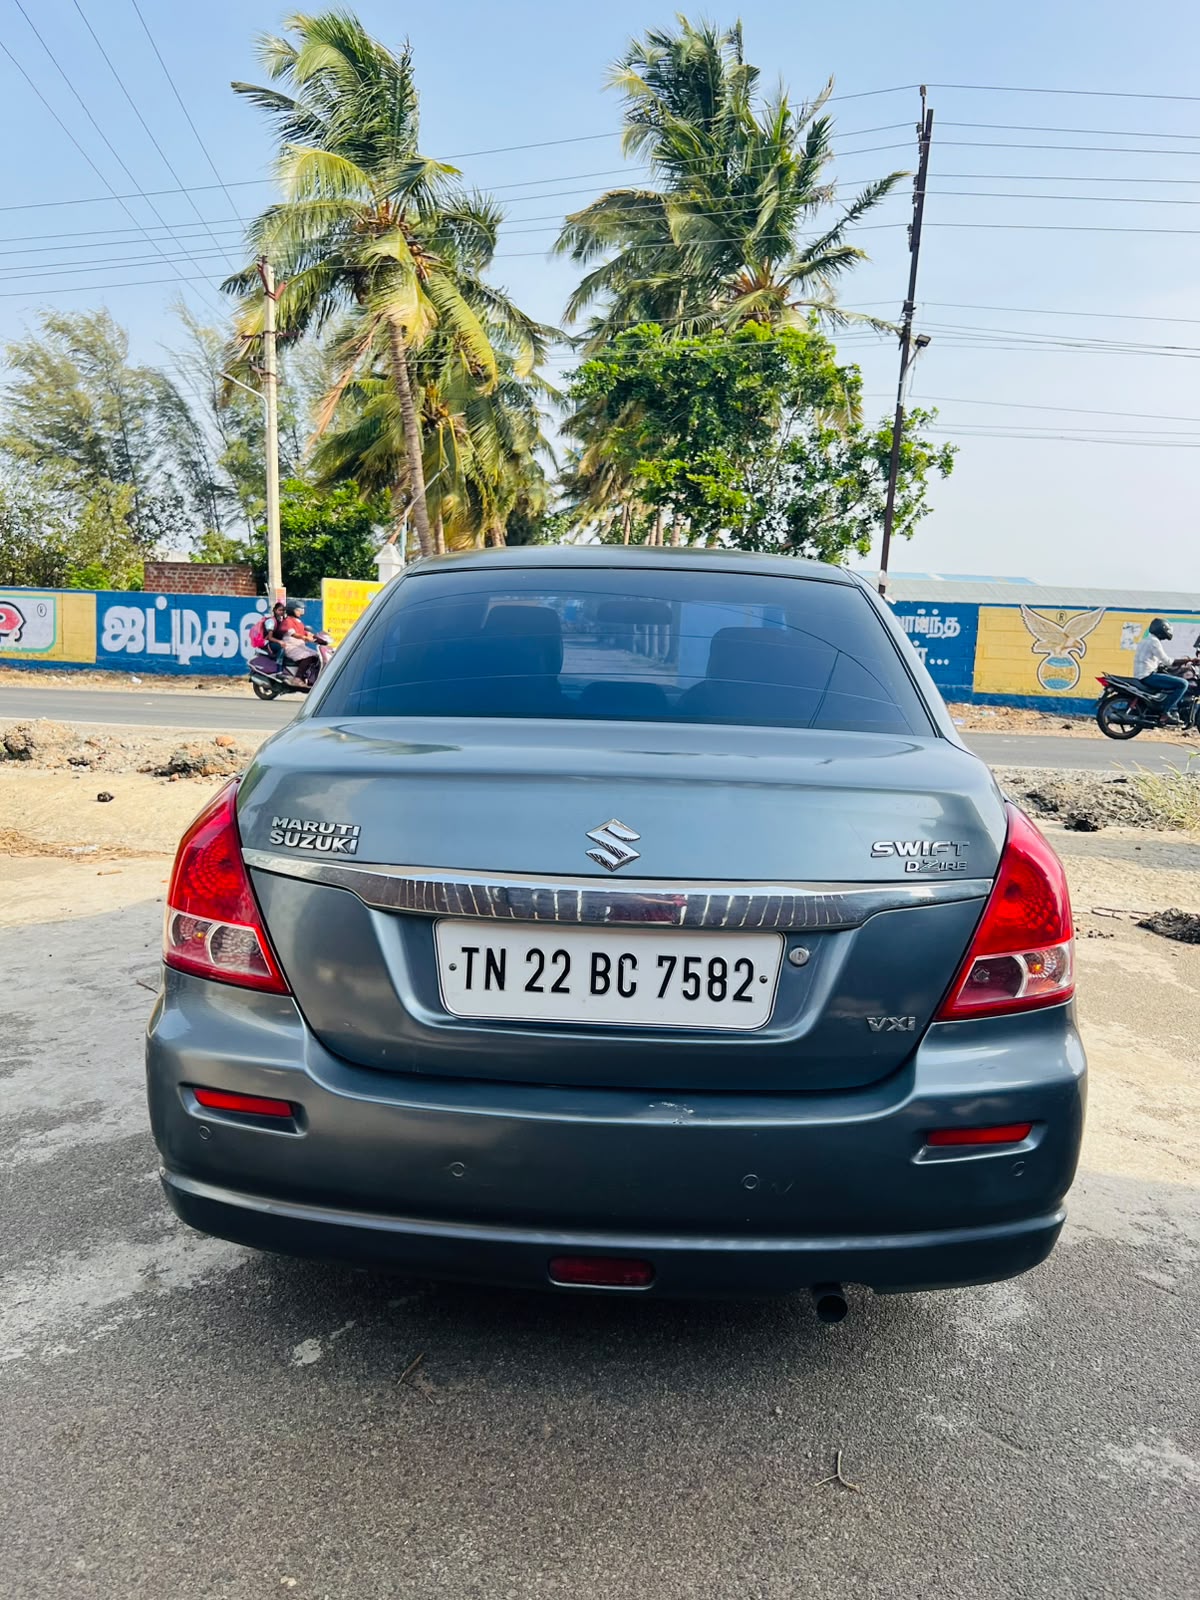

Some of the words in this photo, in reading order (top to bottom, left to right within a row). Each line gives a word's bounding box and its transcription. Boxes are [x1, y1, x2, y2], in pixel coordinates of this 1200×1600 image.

[271, 816, 361, 837] MARUTI
[269, 829, 359, 855] SUZUKI
[870, 840, 970, 858] SWIFT
[905, 859, 968, 873] DZIRE
[461, 946, 507, 991] TN
[524, 948, 572, 994] 22
[590, 952, 638, 998] BC
[656, 954, 755, 1003] 7582
